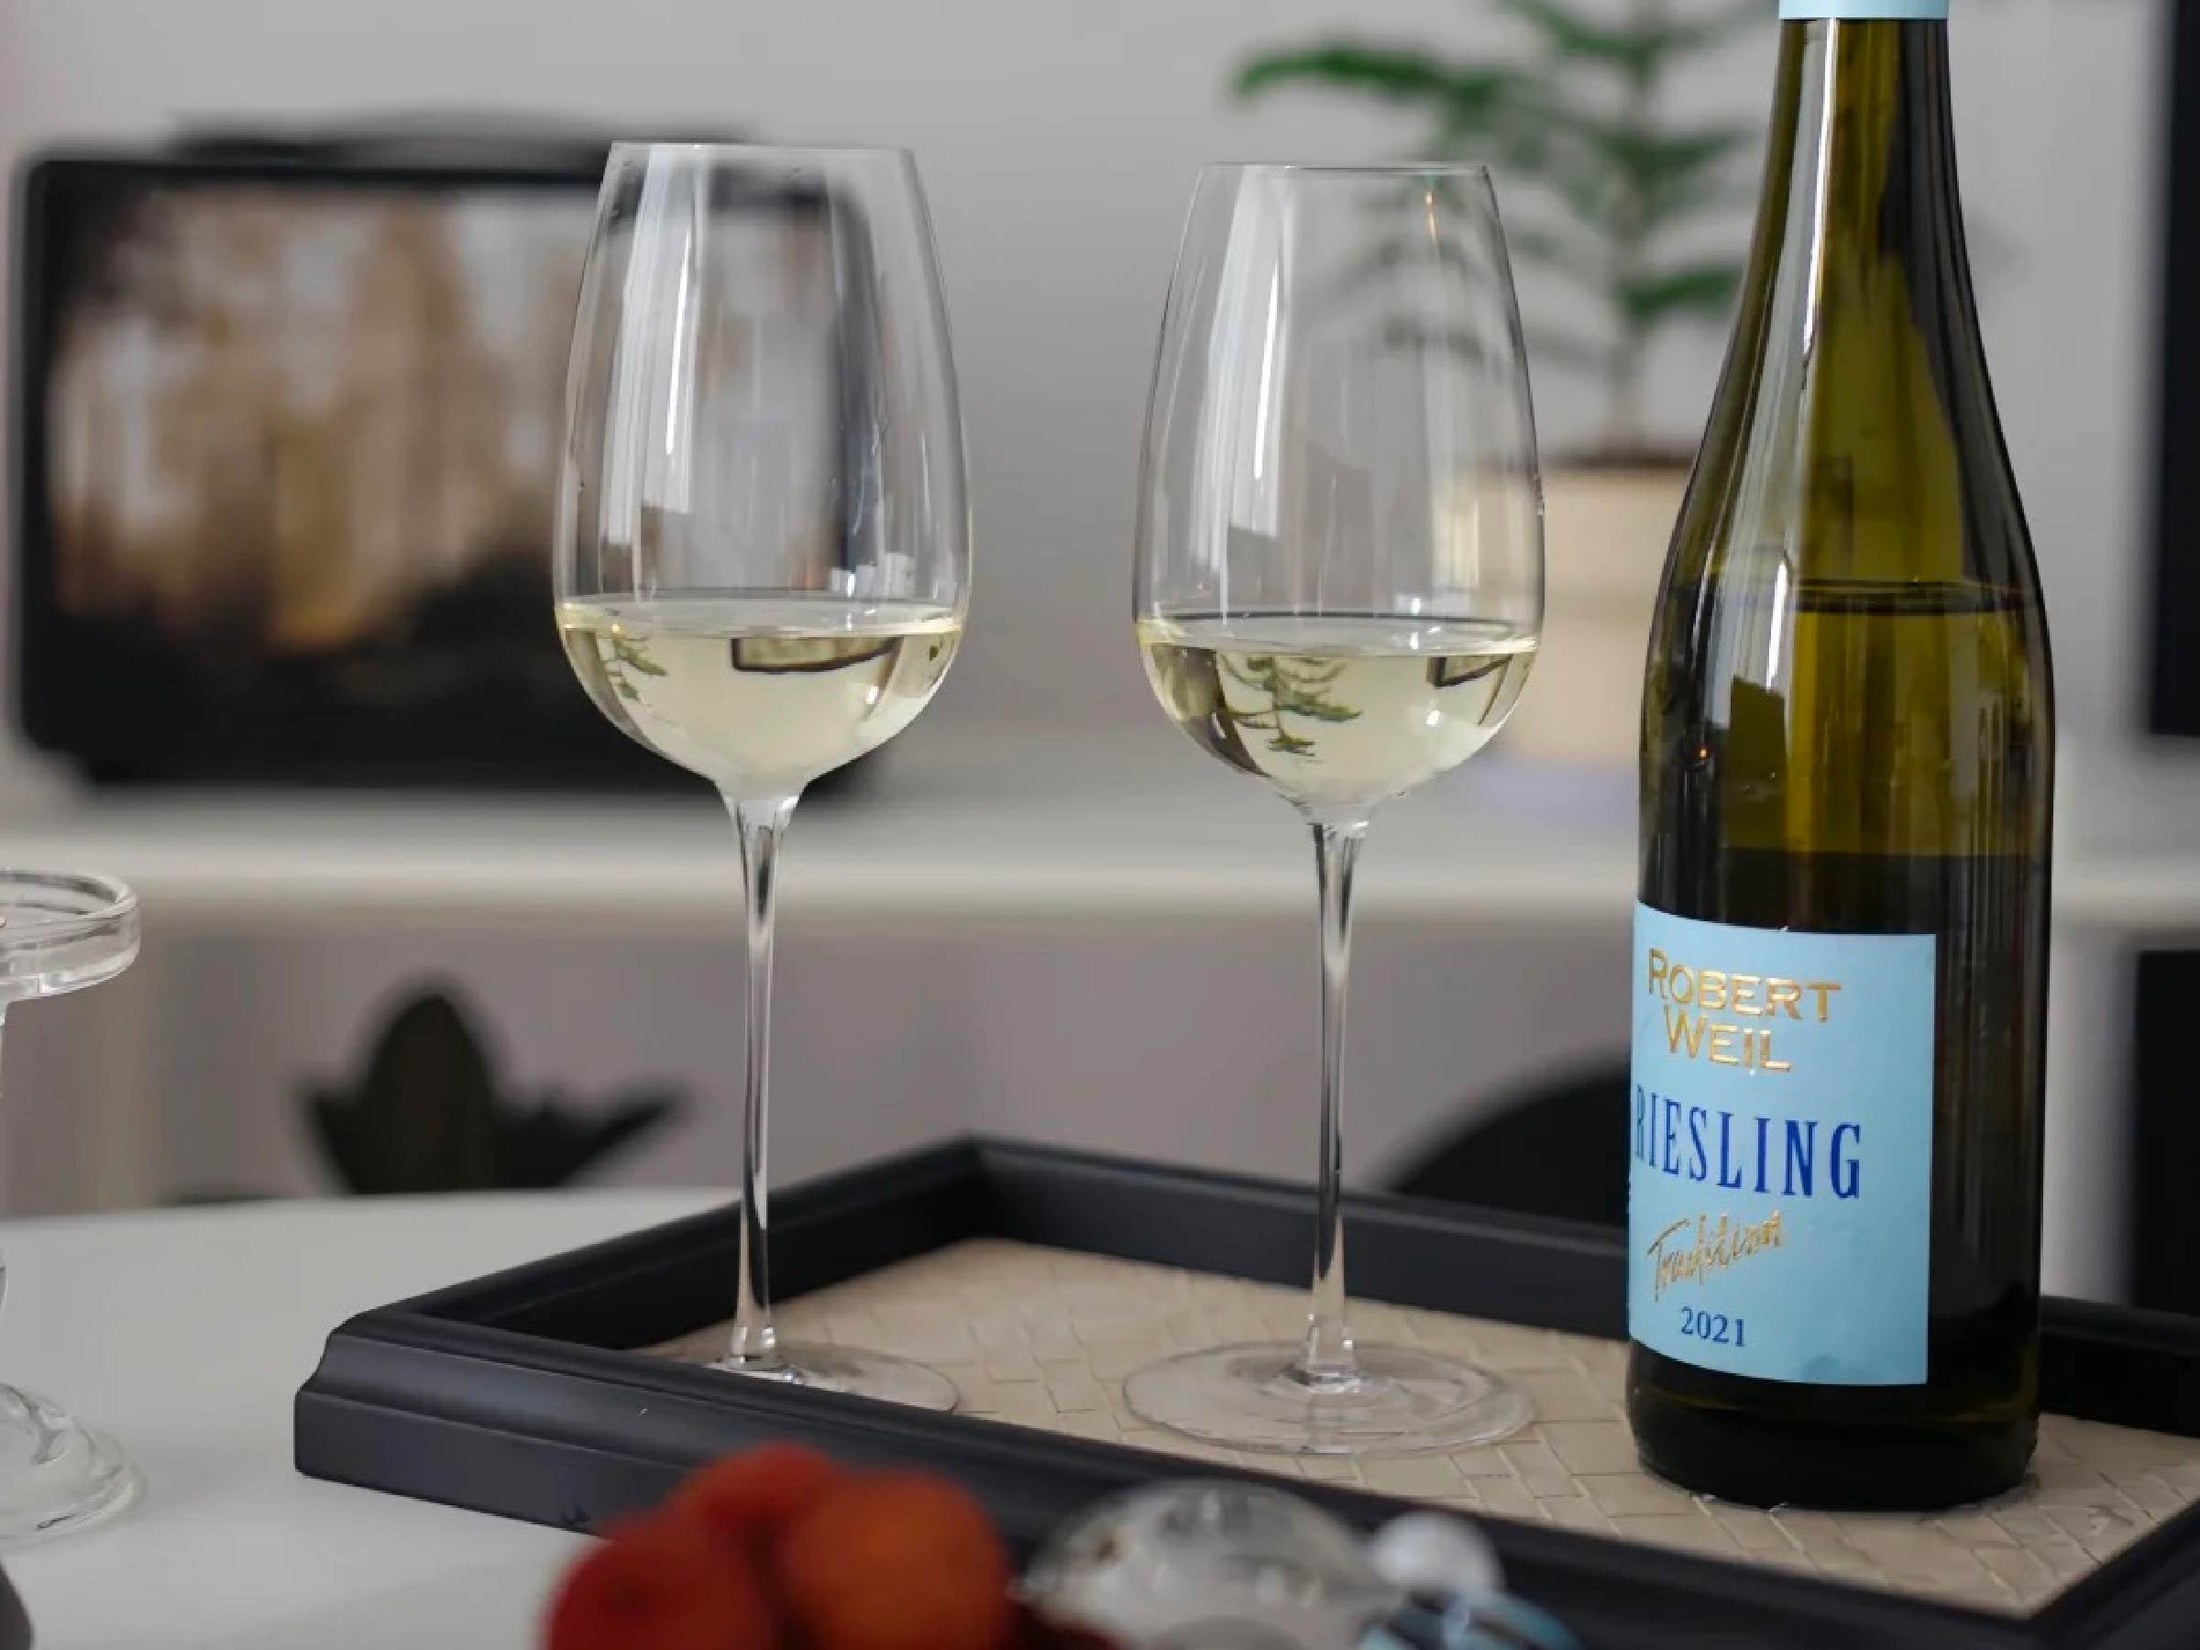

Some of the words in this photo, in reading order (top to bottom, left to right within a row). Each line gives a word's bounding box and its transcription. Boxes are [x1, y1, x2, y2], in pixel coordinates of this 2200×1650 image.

[1648, 948, 1840, 1021] ROBERT
[1664, 1004, 1790, 1072] WEIL
[1635, 1084, 1860, 1198] RIESLING
[1681, 1307, 1746, 1347] 2021
